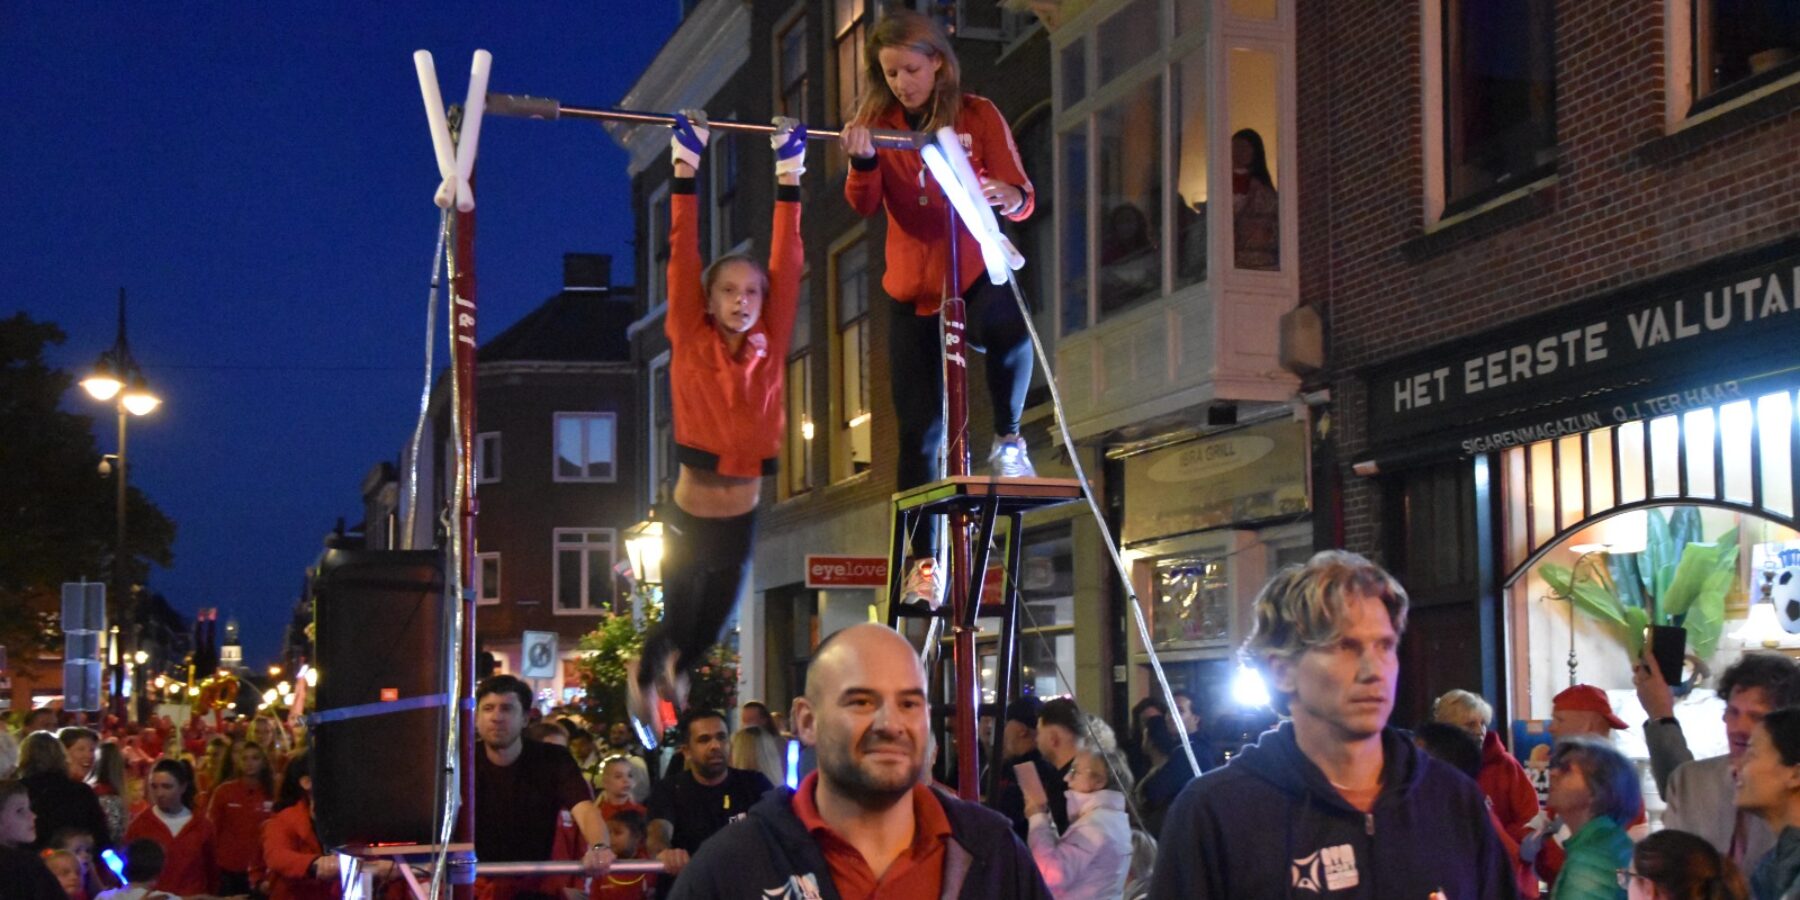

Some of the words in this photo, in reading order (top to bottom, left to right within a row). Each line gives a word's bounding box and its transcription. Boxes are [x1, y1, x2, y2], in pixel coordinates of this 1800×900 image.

[1394, 366, 1450, 412] HET
[1464, 321, 1609, 394] EERSTE
[1461, 410, 1601, 455] SIGARENMAGAZIJN
[1645, 393, 1684, 415] TER
[1685, 380, 1742, 406] HAAR
[811, 561, 887, 581] eyelove
